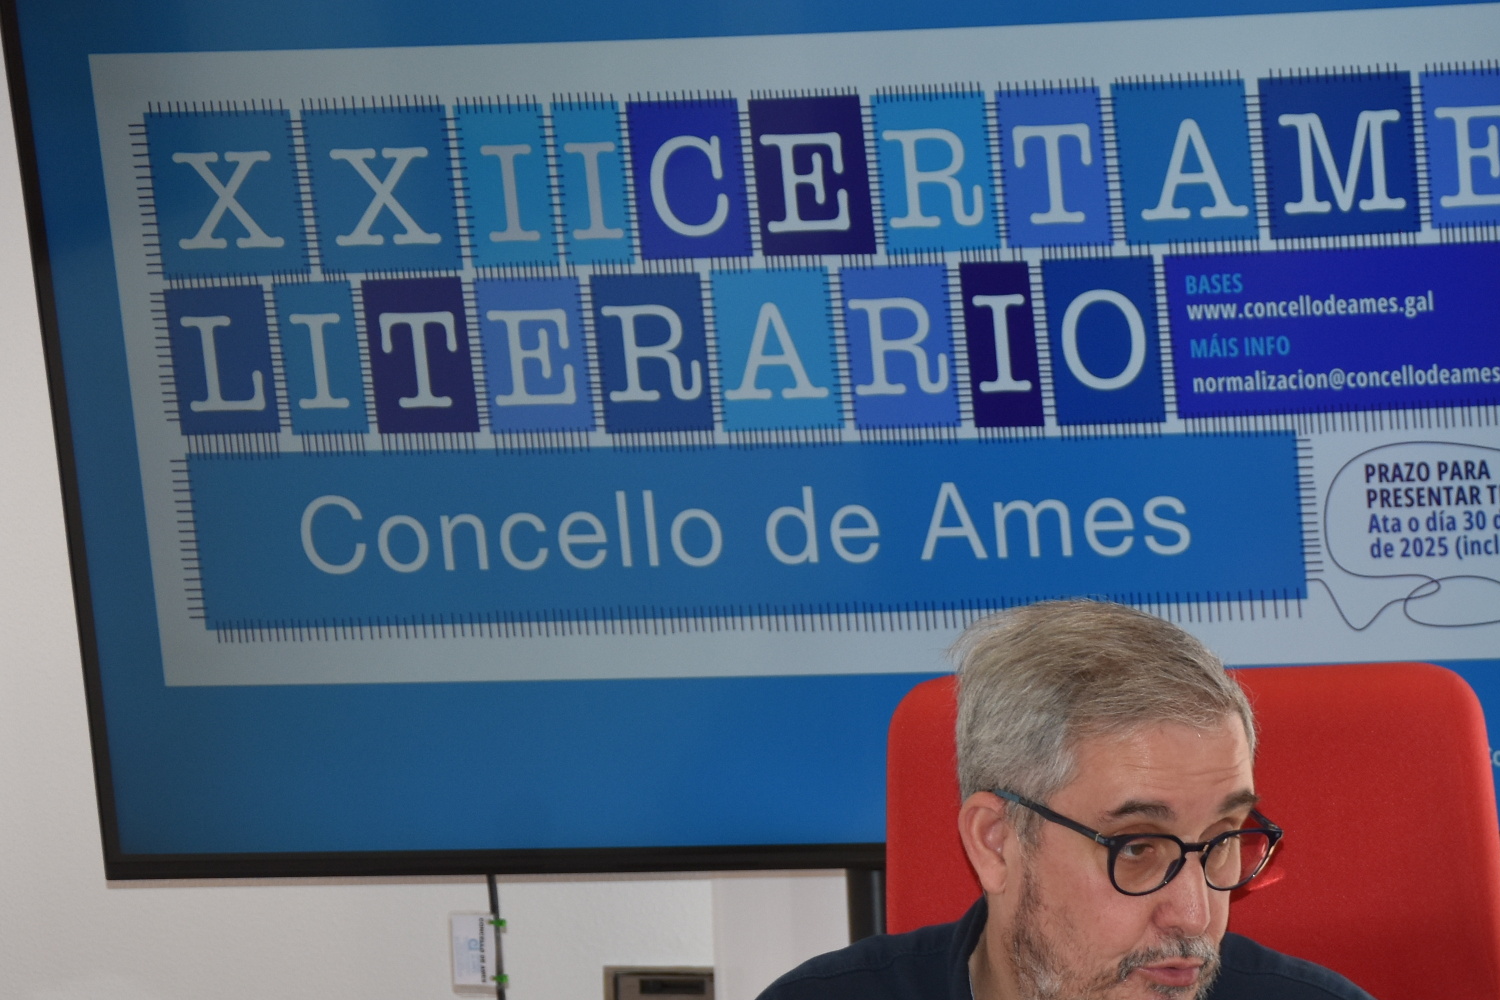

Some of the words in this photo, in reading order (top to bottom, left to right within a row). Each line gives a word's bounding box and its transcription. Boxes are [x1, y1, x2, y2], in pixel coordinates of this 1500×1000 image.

[172, 140, 625, 251] XXII
[1186, 274, 1243, 295] BASES
[1187, 290, 1434, 320] www.concellodeames.gal
[180, 289, 1147, 414] LITERARIO
[1190, 335, 1239, 359] MÁIS
[1244, 336, 1290, 356] INFO
[1364, 462, 1430, 483] PRAZO
[1437, 460, 1490, 481] PARA
[1367, 485, 1482, 508] PRESENTAR
[300, 490, 723, 575] Concello
[764, 485, 881, 566] de
[921, 481, 1191, 562] Ames
[1369, 513, 1402, 533] Ata
[1408, 517, 1418, 532] o
[1426, 509, 1456, 532] día
[1463, 511, 1486, 530] 30
[1370, 538, 1394, 558] de
[1400, 537, 1448, 557] 2025
